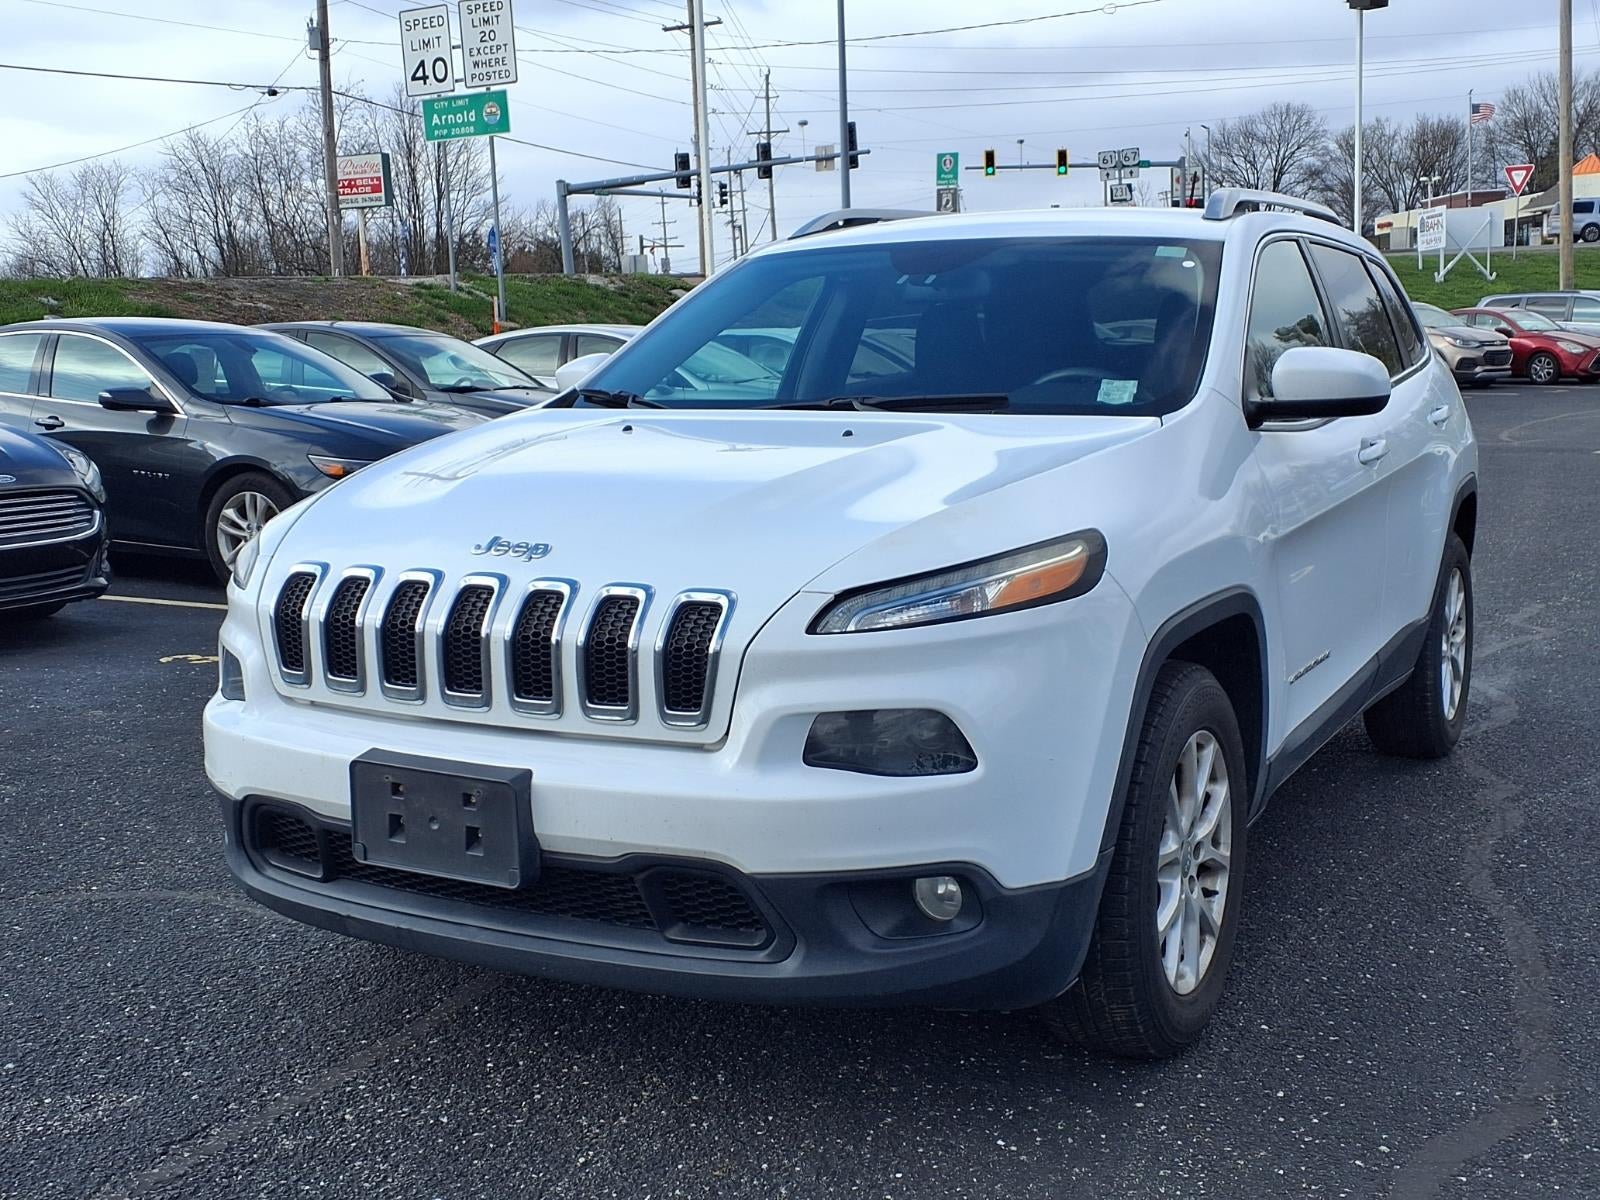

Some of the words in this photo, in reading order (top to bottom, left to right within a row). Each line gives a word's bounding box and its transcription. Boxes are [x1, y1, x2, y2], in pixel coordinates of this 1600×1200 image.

[466, 1, 504, 15] SPEED
[405, 15, 445, 32] SPEED
[471, 15, 501, 28] LIMIT
[479, 29, 496, 43] 20
[410, 36, 442, 52] LIMIT
[469, 43, 509, 57] EXCEPT
[472, 57, 508, 69] WHERE
[410, 56, 449, 86] 40
[471, 69, 511, 83] POSTED
[434, 101, 449, 109] CITY
[452, 98, 469, 107] LIMIT
[431, 109, 476, 127] Arnold
[434, 128, 448, 137] POP
[1102, 154, 1113, 165] 61
[1123, 151, 1138, 162] 67
[355, 177, 380, 186] SELL
[338, 186, 372, 195] TRADE
[1113, 186, 1128, 198] 231
[1425, 218, 1444, 233] BAHN
[470, 535, 553, 563] Jeep
